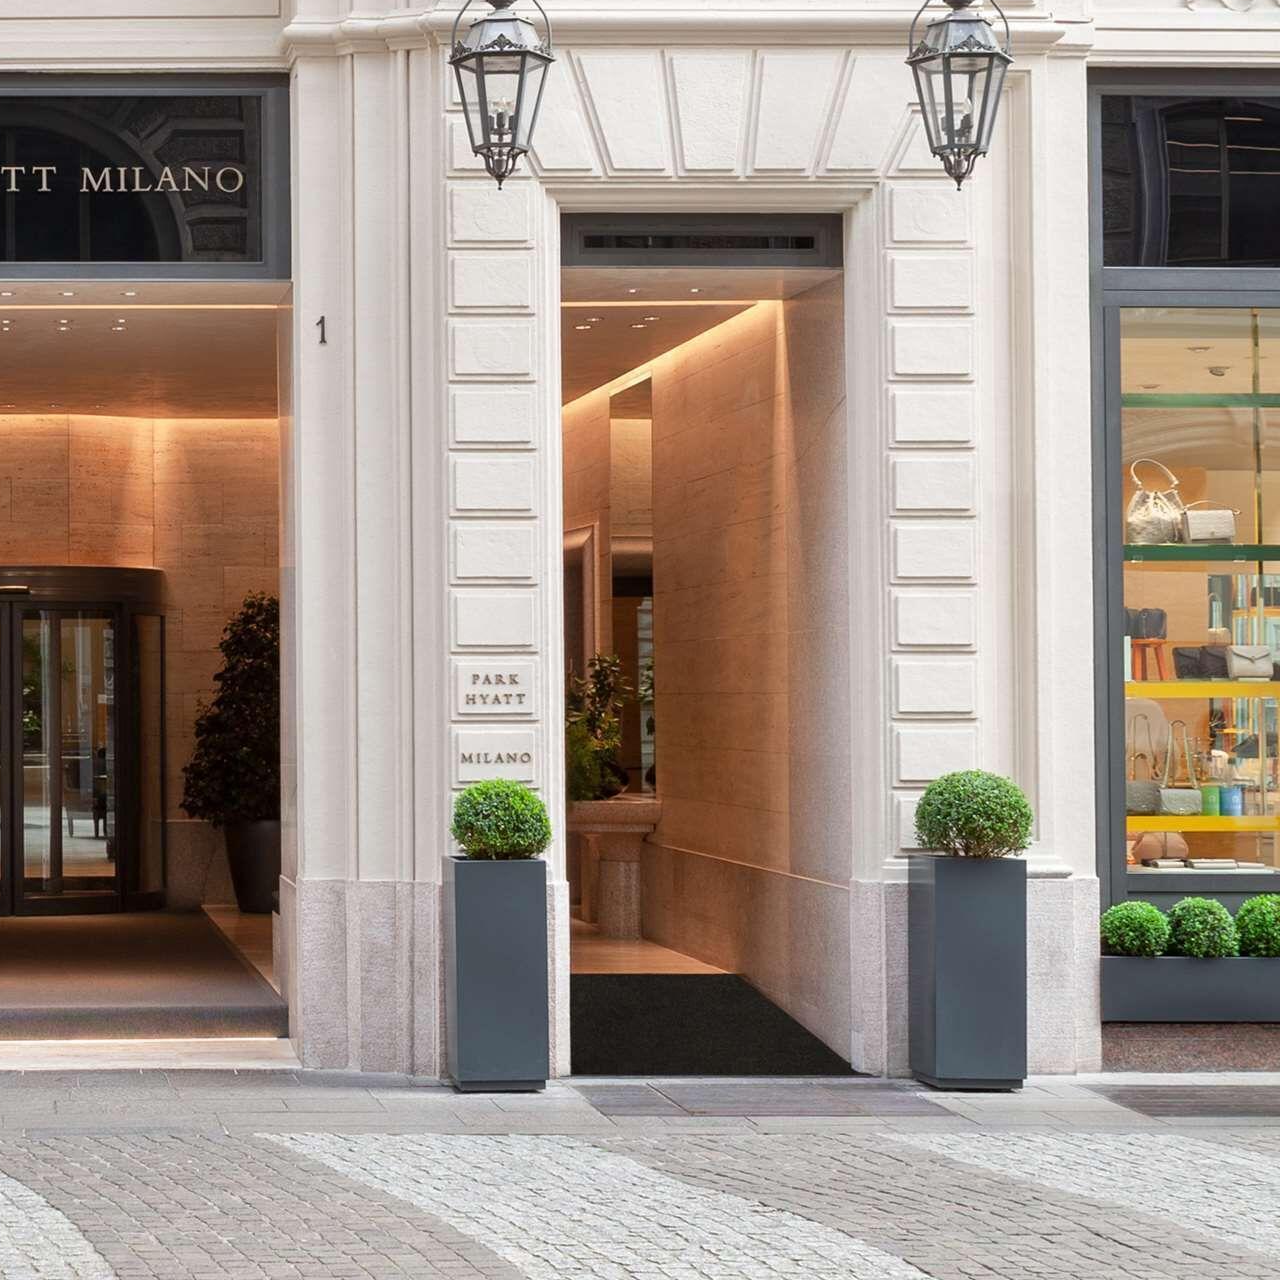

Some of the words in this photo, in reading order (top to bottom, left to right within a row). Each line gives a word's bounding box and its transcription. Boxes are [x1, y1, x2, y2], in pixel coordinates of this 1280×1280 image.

[79, 165, 245, 193] MILANO
[315, 315, 327, 345] 1
[471, 673, 520, 685] PARK
[465, 693, 526, 705] HYATT
[460, 752, 532, 764] MILANO
